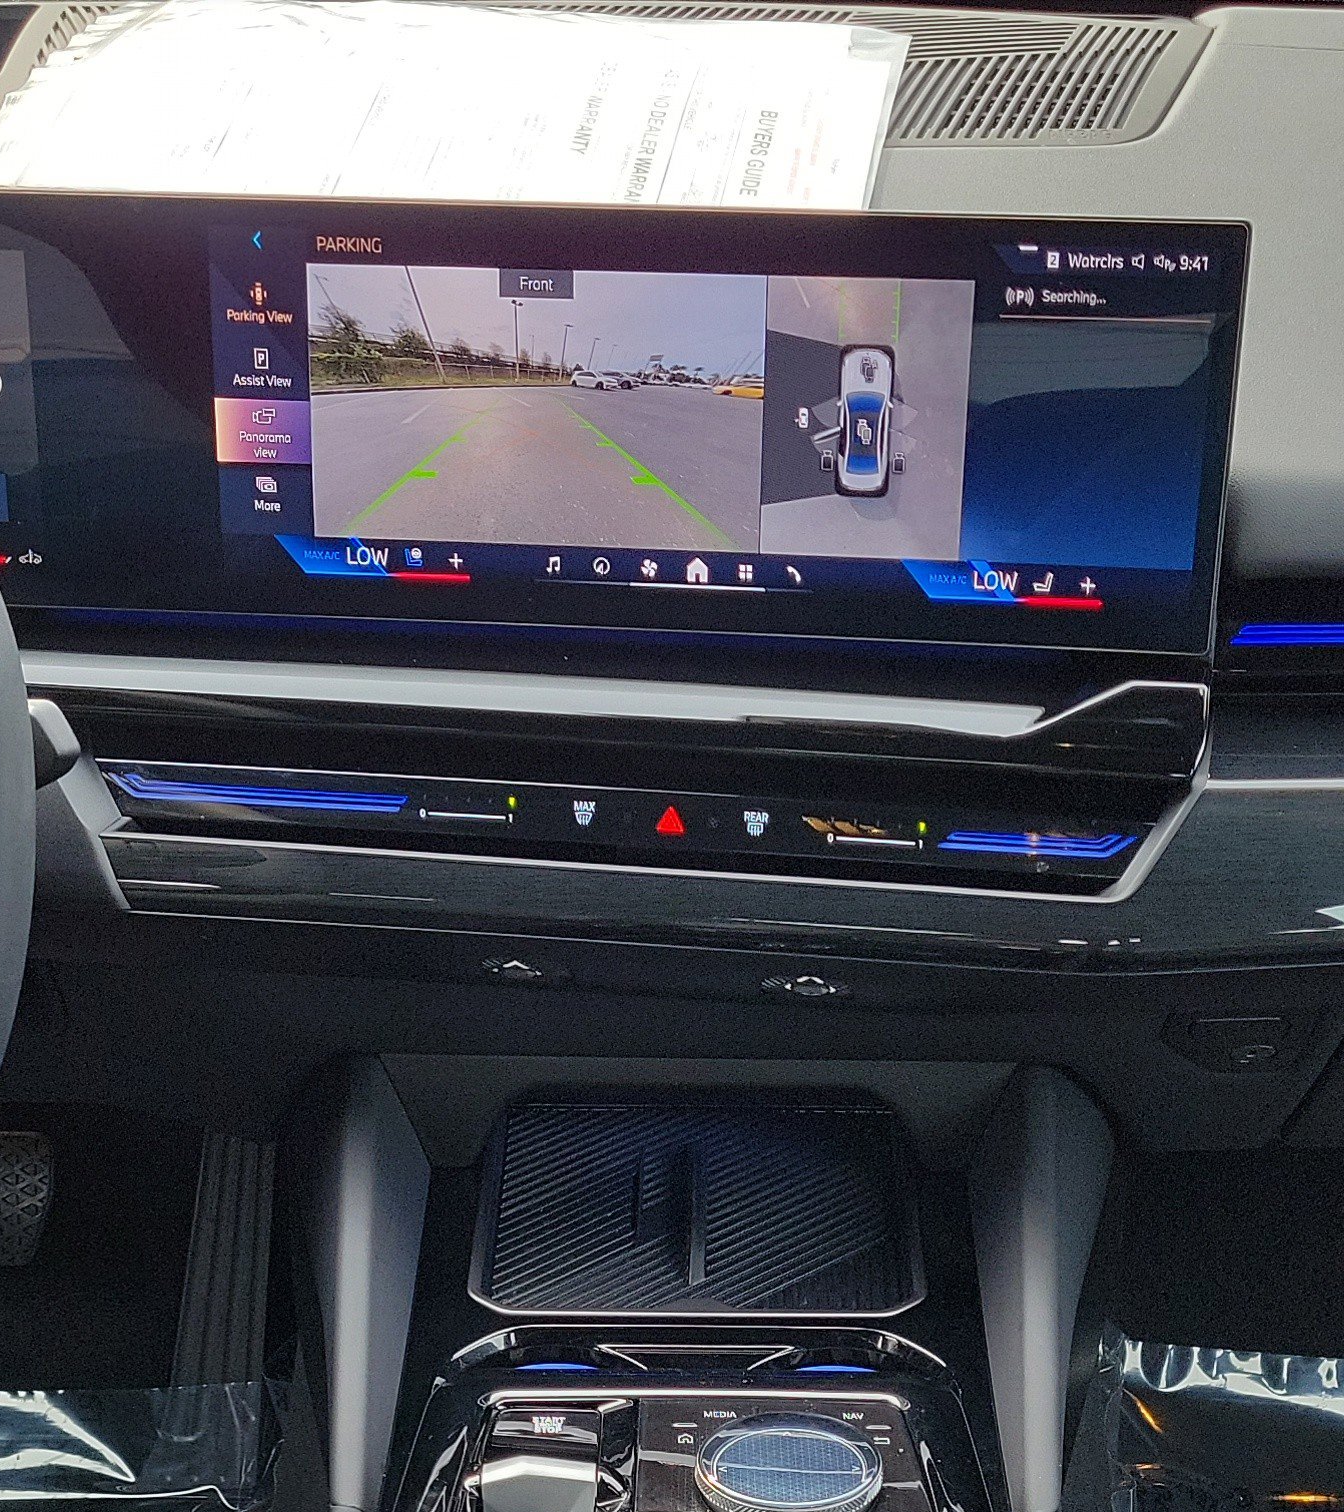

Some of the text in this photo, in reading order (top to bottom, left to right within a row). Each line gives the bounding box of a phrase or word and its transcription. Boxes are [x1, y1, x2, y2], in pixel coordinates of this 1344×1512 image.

[637, 110, 666, 155] DEALER
[739, 109, 779, 197] BUYERS GUIDE
[316, 236, 382, 254] PARKING
[1179, 255, 1209, 271] 9:41
[519, 275, 554, 292] Front
[227, 309, 293, 325] Parking View
[233, 374, 292, 388] Assist View
[239, 431, 292, 445] Panorama
[254, 446, 277, 459] view
[254, 499, 281, 513] More
[346, 546, 389, 567] LOW
[973, 570, 1019, 591] LOW
[573, 801, 596, 813] MAX
[744, 811, 769, 824] REAR
[703, 1410, 737, 1418] MEDIA
[842, 1412, 865, 1420] NAV
